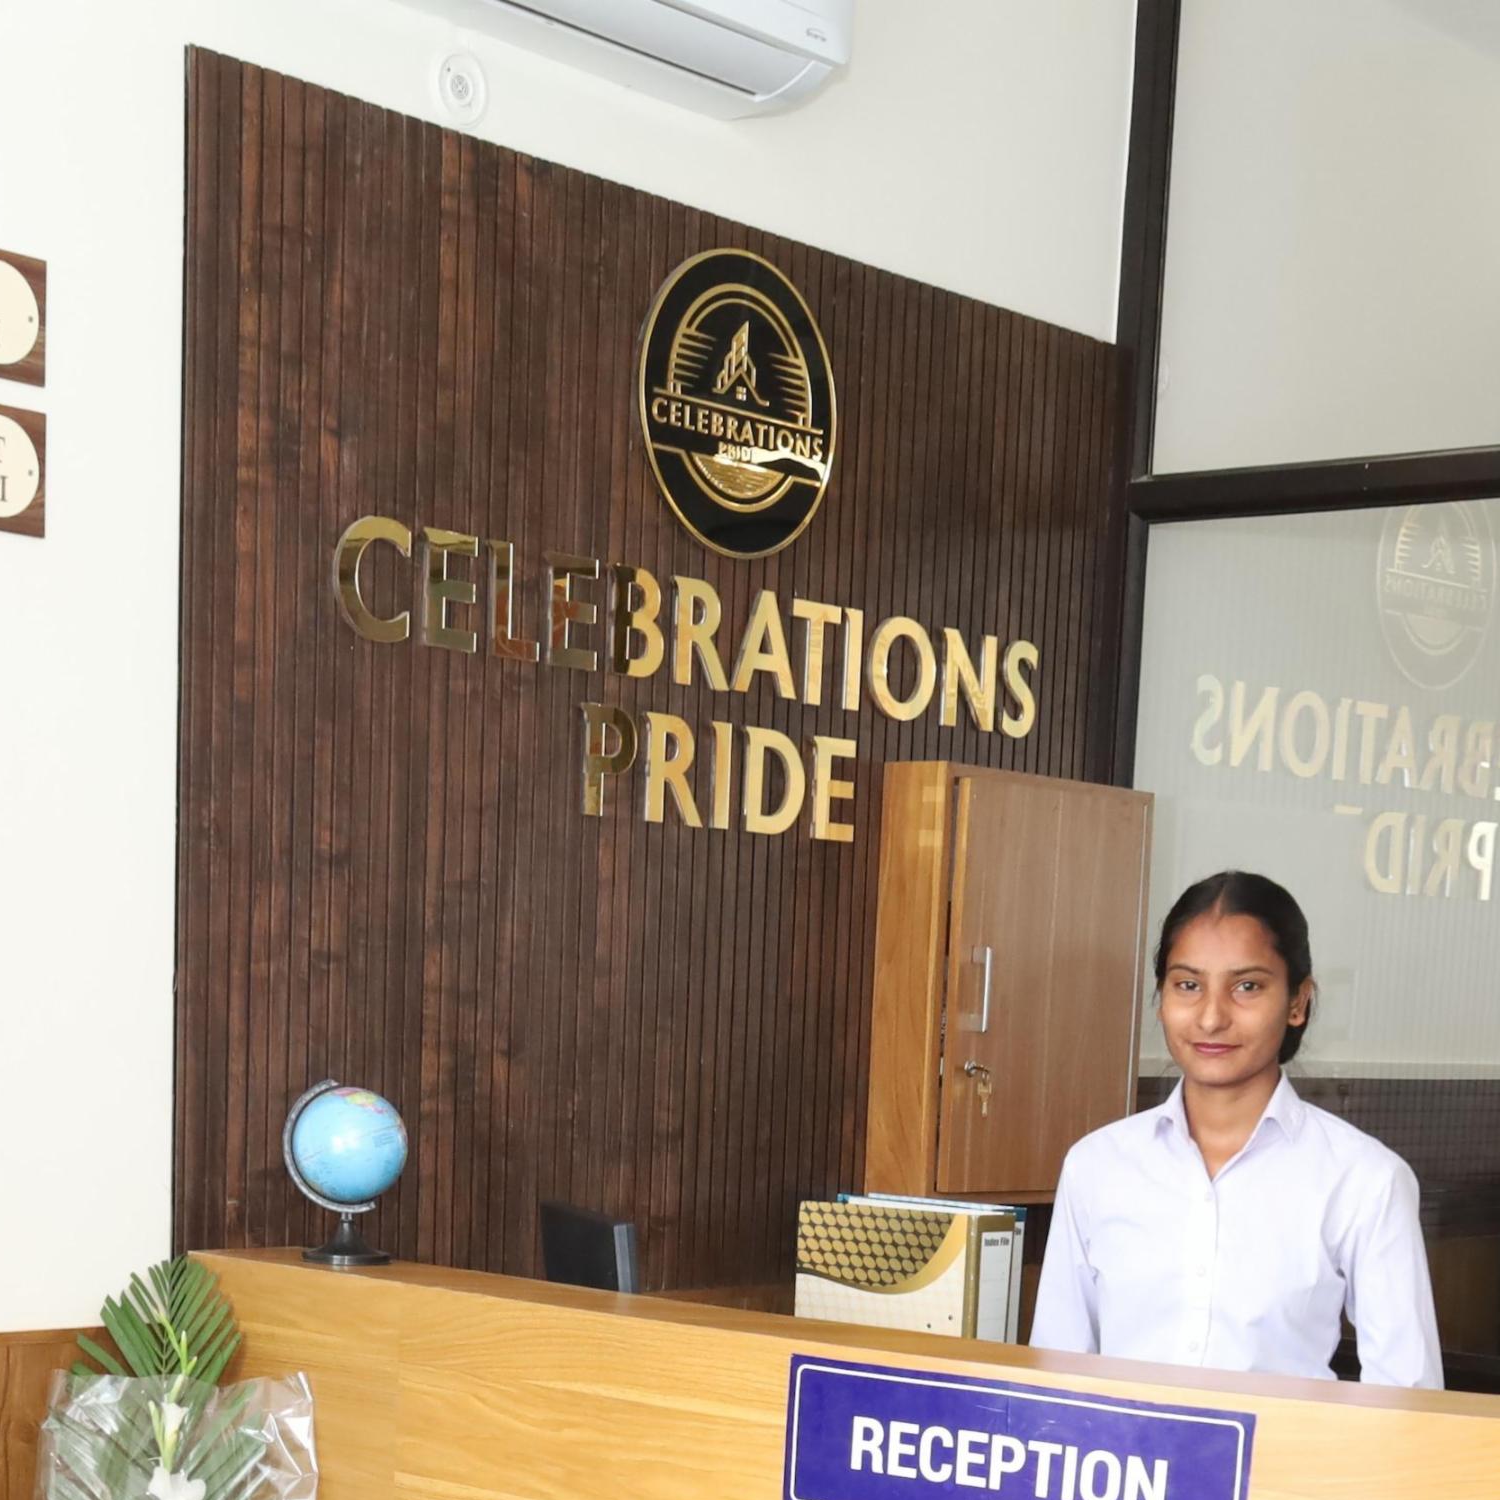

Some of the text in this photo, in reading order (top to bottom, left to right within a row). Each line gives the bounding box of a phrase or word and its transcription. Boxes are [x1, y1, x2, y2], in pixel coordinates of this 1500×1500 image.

[651, 397, 823, 463] CELEBRATIONS
[332, 515, 1040, 739] CELEBRATIONS
[580, 702, 854, 842] PRIDE
